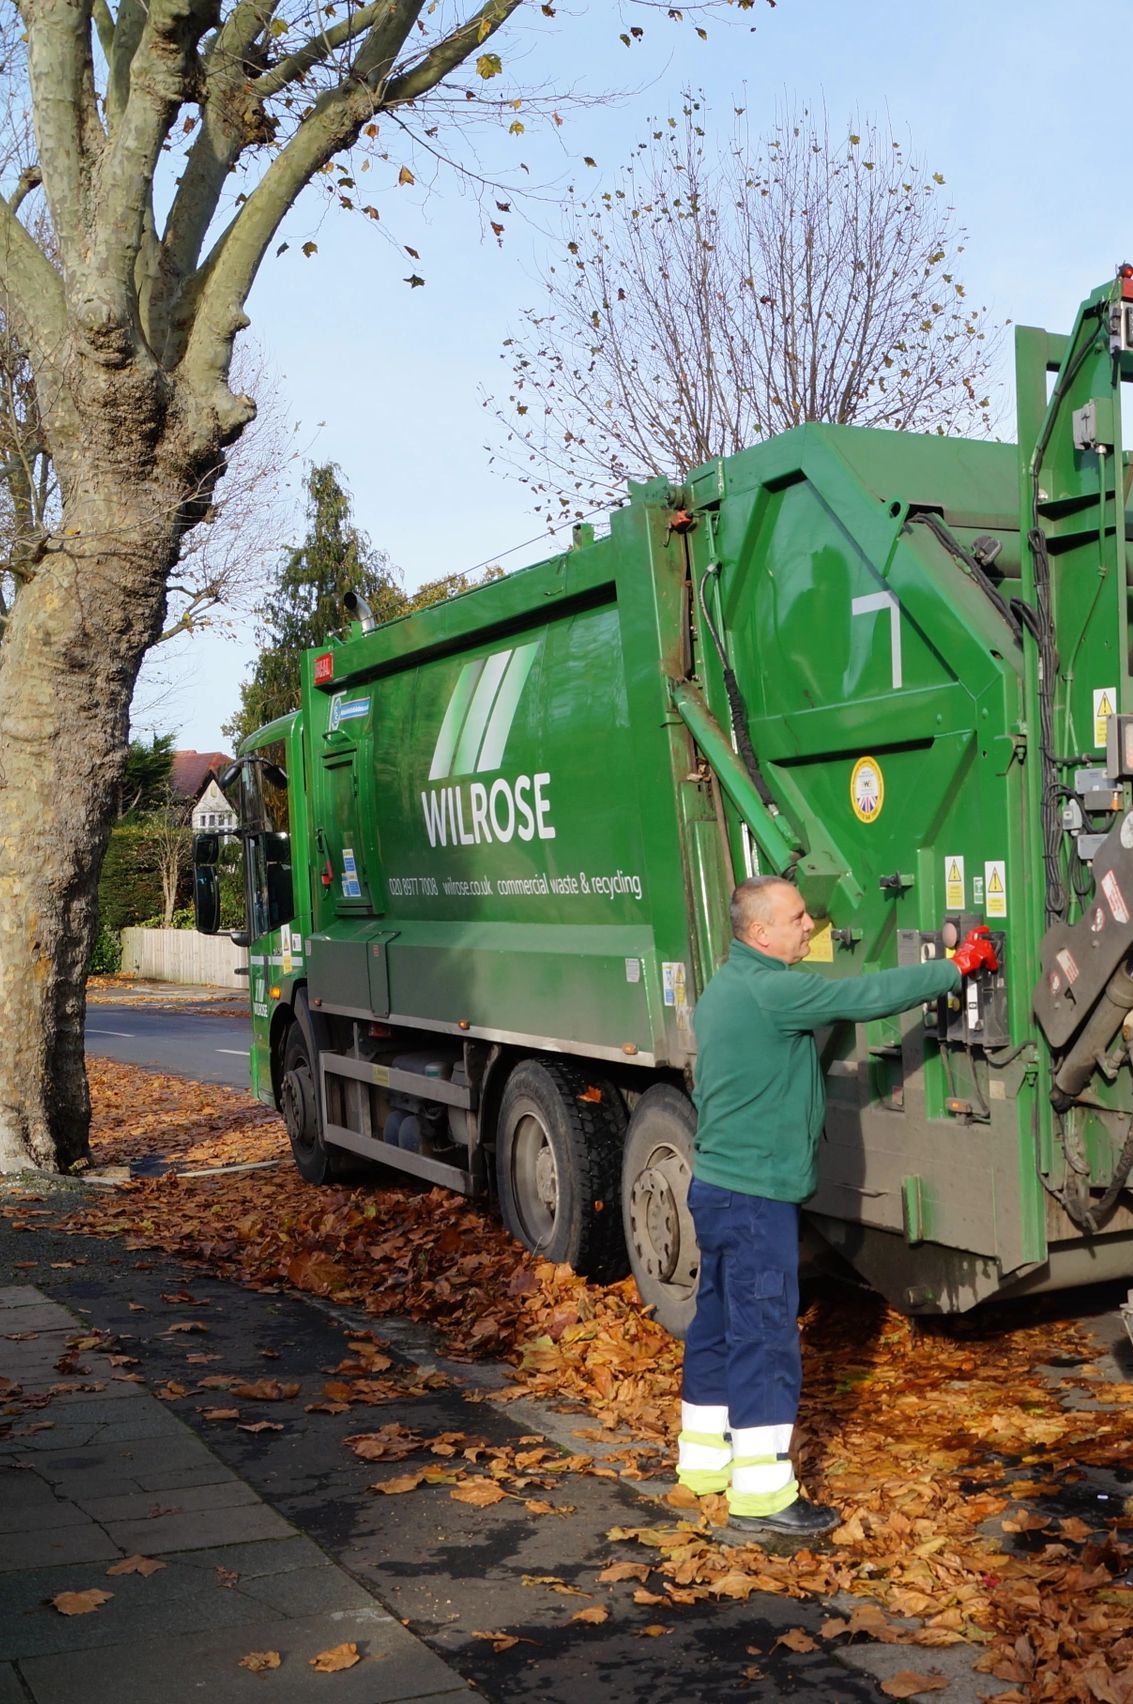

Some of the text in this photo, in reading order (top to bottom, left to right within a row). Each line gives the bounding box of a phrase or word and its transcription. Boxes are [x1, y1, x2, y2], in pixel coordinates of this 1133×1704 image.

[421, 772, 556, 848] WILROSE
[389, 878, 402, 896] 020
[403, 878, 420, 896] 8977
[442, 874, 493, 896] wilrose.co.uk
[496, 873, 549, 896] commercial
[550, 877, 580, 895] waste
[580, 871, 591, 895] &
[592, 870, 642, 900] recycling
